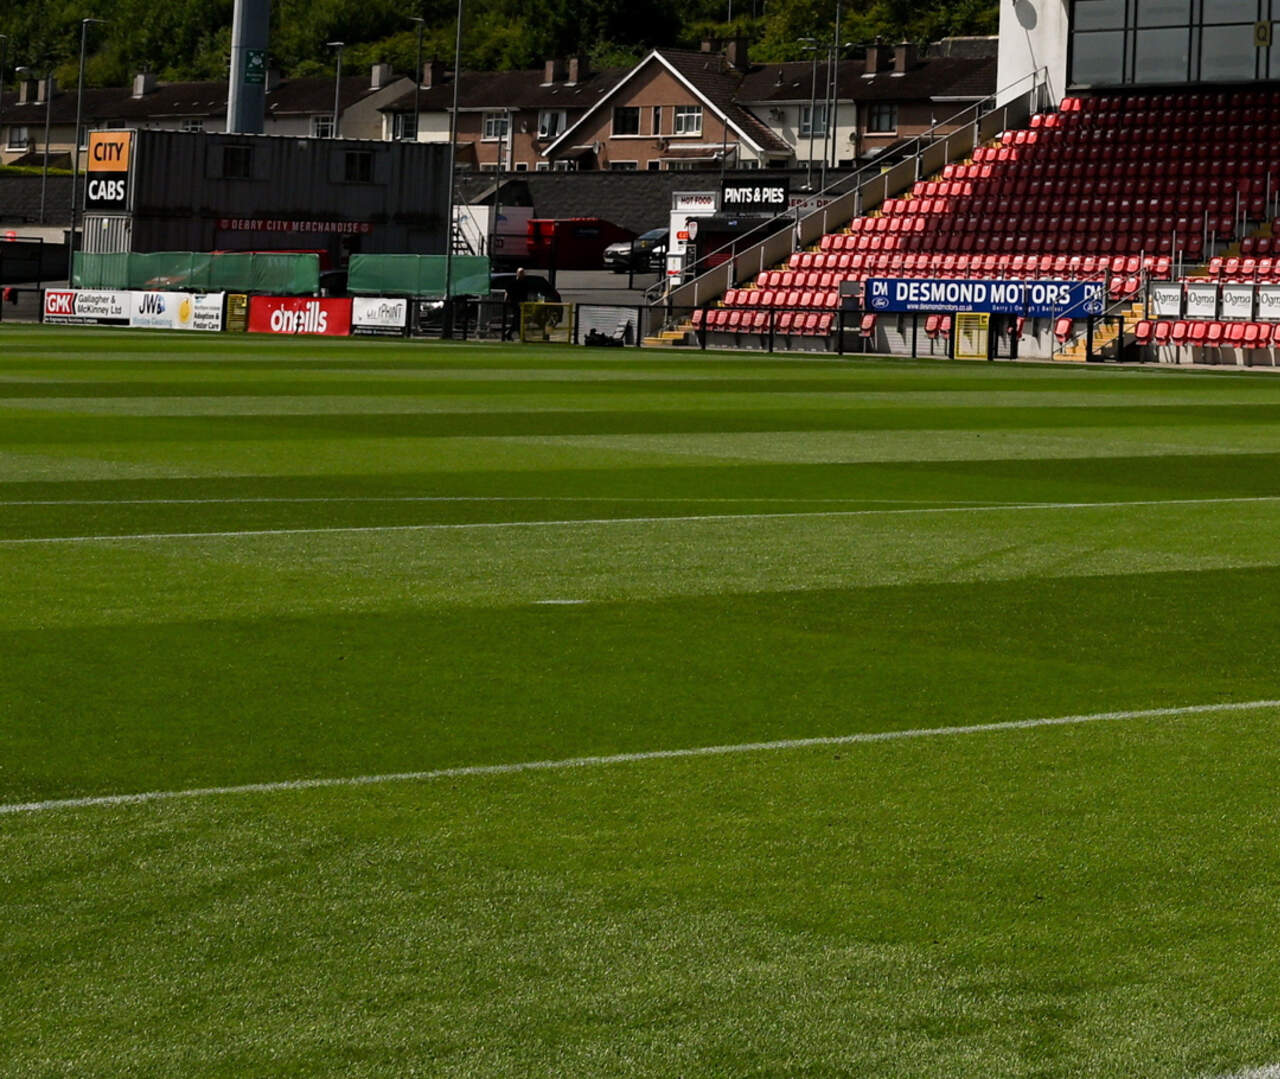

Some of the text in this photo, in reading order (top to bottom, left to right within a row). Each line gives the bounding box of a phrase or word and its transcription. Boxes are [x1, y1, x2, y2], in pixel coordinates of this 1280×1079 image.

[94, 142, 124, 161] CITY
[88, 180, 125, 200] CABS
[724, 188, 752, 203] PINTS
[753, 187, 761, 202] &
[762, 188, 784, 203] PIES
[681, 196, 712, 204] HOT FOOD
[231, 220, 358, 232] DERRY CITY MERCHANDISE
[872, 282, 888, 296] DM
[896, 282, 1071, 304] DESMOND MOTORS
[47, 293, 71, 313] GMK
[78, 294, 116, 305] Gallagher &
[1154, 290, 1179, 305] Ogma
[1189, 292, 1215, 305] Ogma
[1225, 292, 1251, 306] Ogma
[77, 304, 122, 315] McKinney Ltd
